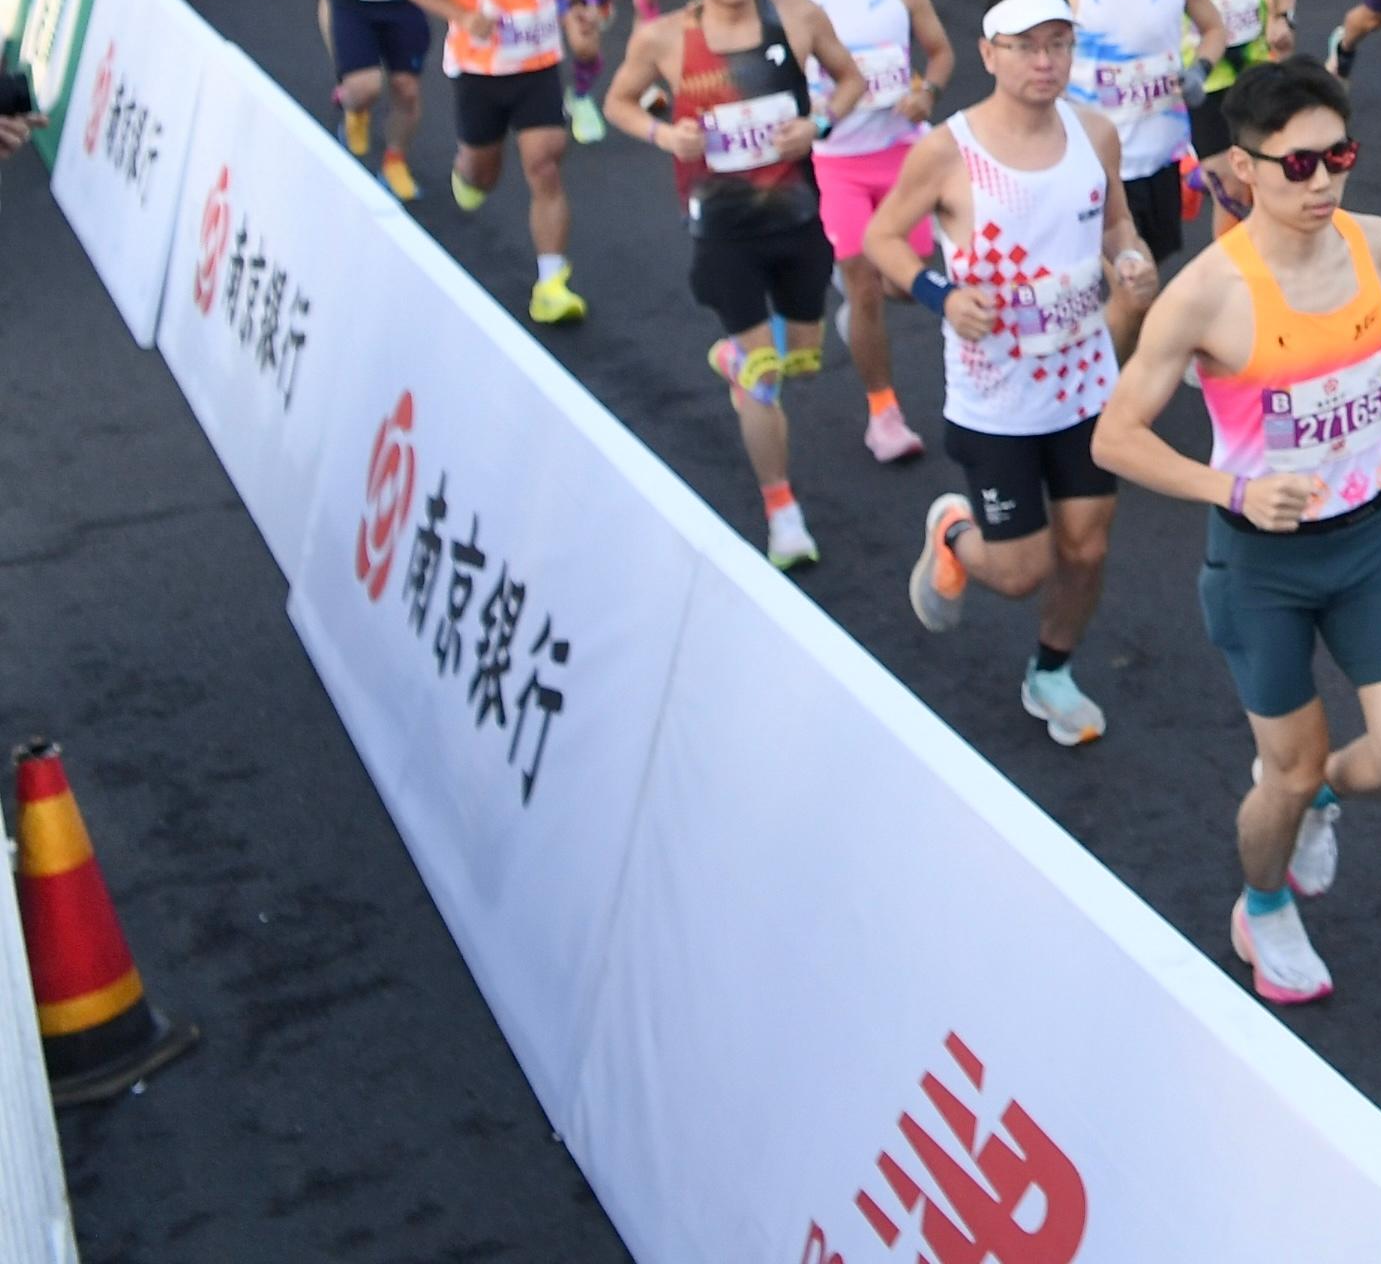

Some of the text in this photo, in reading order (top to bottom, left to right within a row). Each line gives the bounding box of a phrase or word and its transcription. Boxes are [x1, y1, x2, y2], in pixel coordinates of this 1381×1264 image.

[223, 214, 313, 416] 南京银行
[1271, 392, 1292, 415] B
[401, 471, 575, 808] 南京银行
